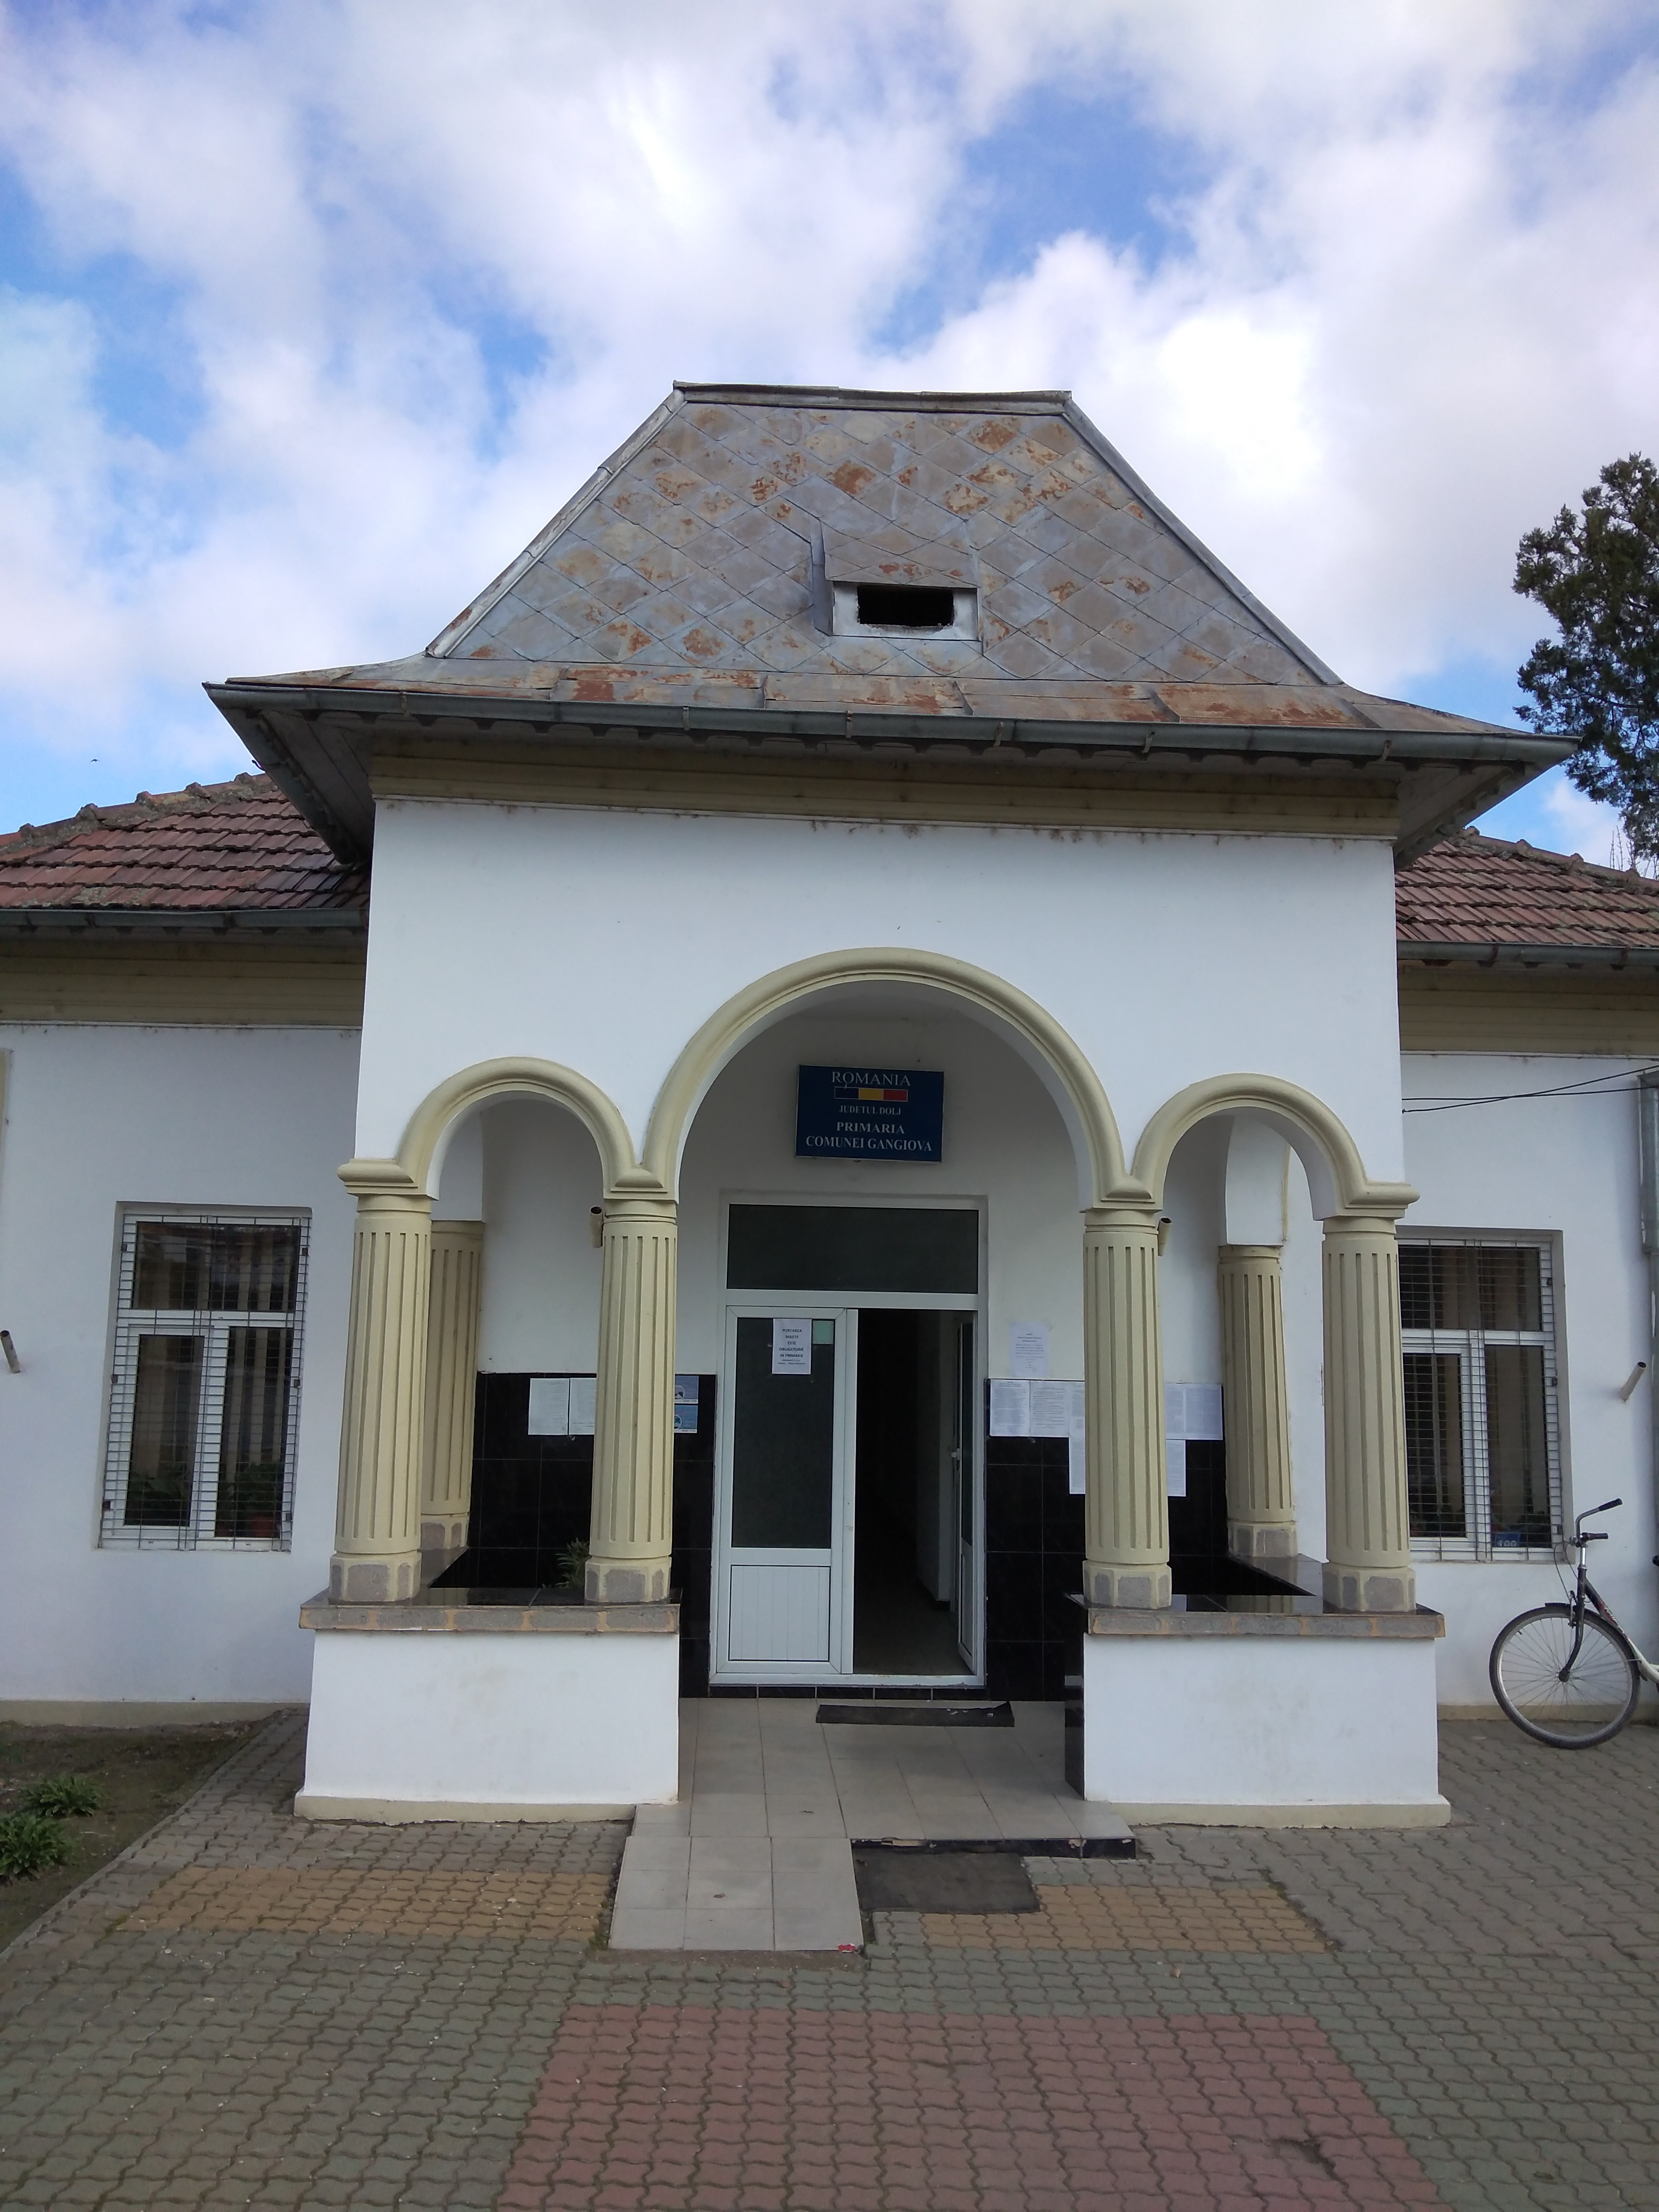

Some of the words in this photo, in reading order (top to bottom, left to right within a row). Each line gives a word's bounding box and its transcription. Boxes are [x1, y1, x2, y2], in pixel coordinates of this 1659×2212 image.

[831, 1071, 911, 1086] ROMANIA
[839, 1105, 877, 1115] JUDETUL
[879, 1107, 901, 1116] DOLJ
[836, 1121, 906, 1134] PRIMARIA
[806, 1135, 864, 1149] COMUNEI
[867, 1138, 932, 1152] GANGIOVA
